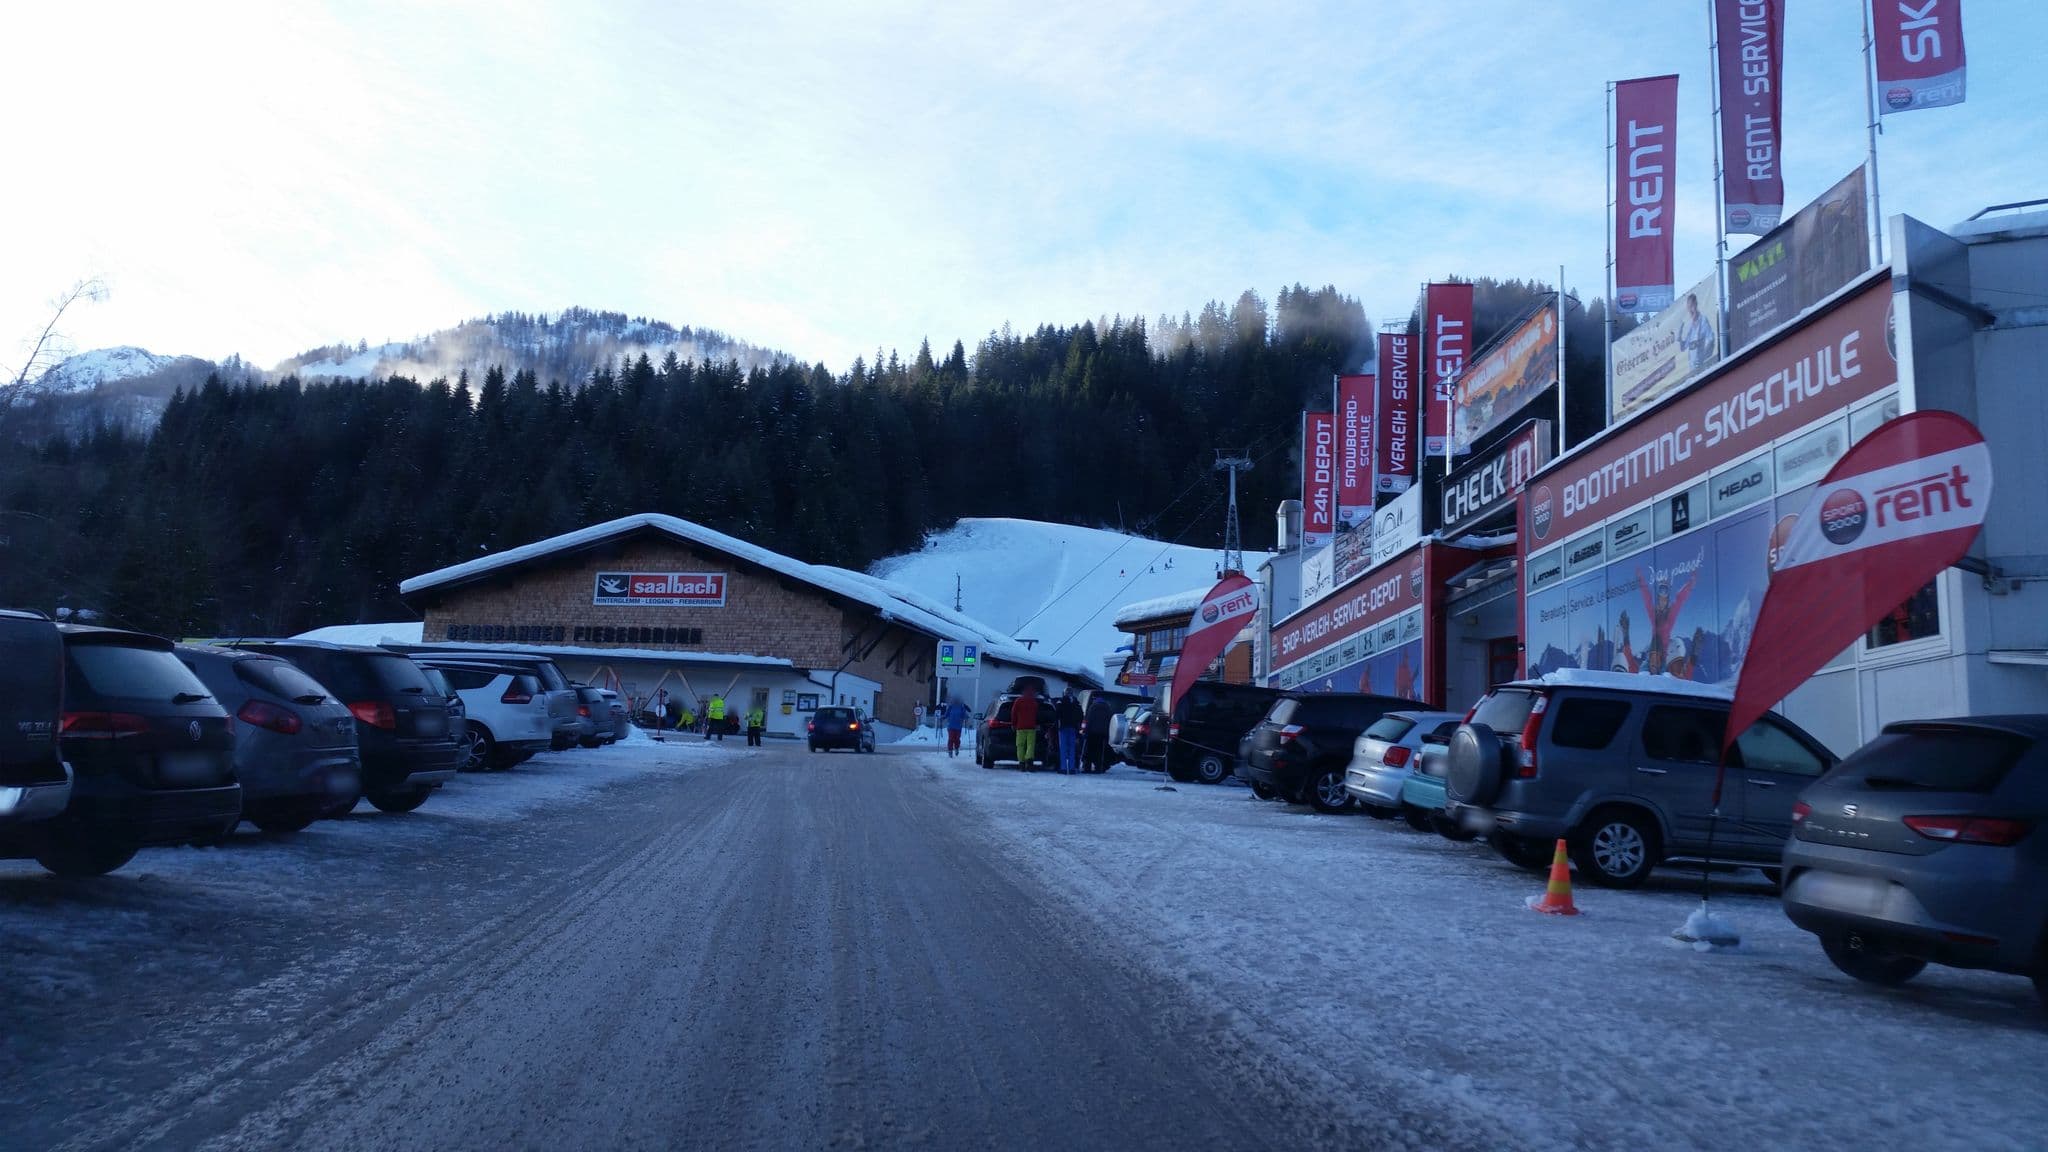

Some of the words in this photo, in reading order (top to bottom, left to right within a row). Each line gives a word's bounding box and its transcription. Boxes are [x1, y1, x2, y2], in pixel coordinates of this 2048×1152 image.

[1744, 114, 1772, 181] RENT
[1629, 120, 1664, 239] RENT
[1392, 336, 1408, 400] SERVICE
[1315, 420, 1331, 483] DEPOT
[1360, 415, 1371, 466] SCHULE
[1390, 410, 1408, 472] VERLEIH
[1444, 455, 1506, 525] CHECK
[1718, 472, 1763, 501] HEAD
[1873, 464, 1974, 529] rent
[1313, 487, 1329, 524] 24h
[1533, 499, 1551, 515] SPORT
[1535, 511, 1550, 525] 2000
[1823, 501, 1864, 522] SPORT
[1827, 514, 1862, 532] 2000
[1615, 522, 1639, 540] elan
[634, 575, 717, 594] saalbach
[1370, 574, 1402, 611] DEPOT
[1537, 566, 1561, 582] ATOMIC
[1220, 591, 1253, 616] rent
